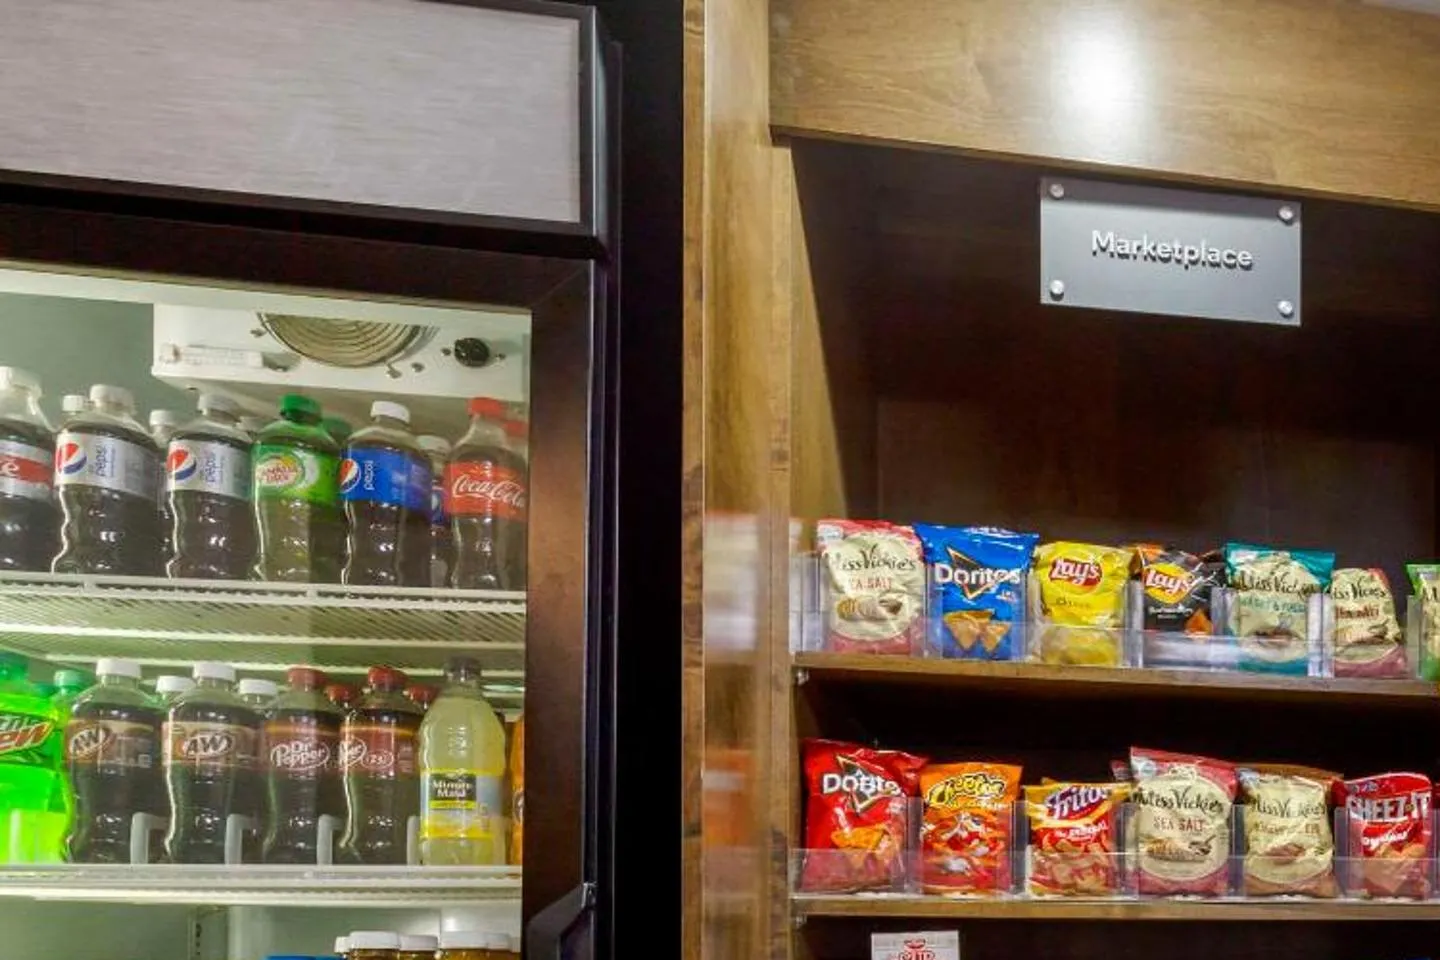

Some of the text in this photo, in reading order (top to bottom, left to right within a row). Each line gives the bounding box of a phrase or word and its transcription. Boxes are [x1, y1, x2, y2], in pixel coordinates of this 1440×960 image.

[1091, 229, 1253, 269] Marketplace
[934, 563, 1021, 586] Doritos
[1052, 558, 1101, 585] Lay's
[1146, 570, 1196, 595] Lay's
[274, 744, 327, 769] Pepper
[290, 740, 312, 752] Dr
[1045, 785, 1110, 820] Fritos
[1178, 818, 1207, 831] SALT
